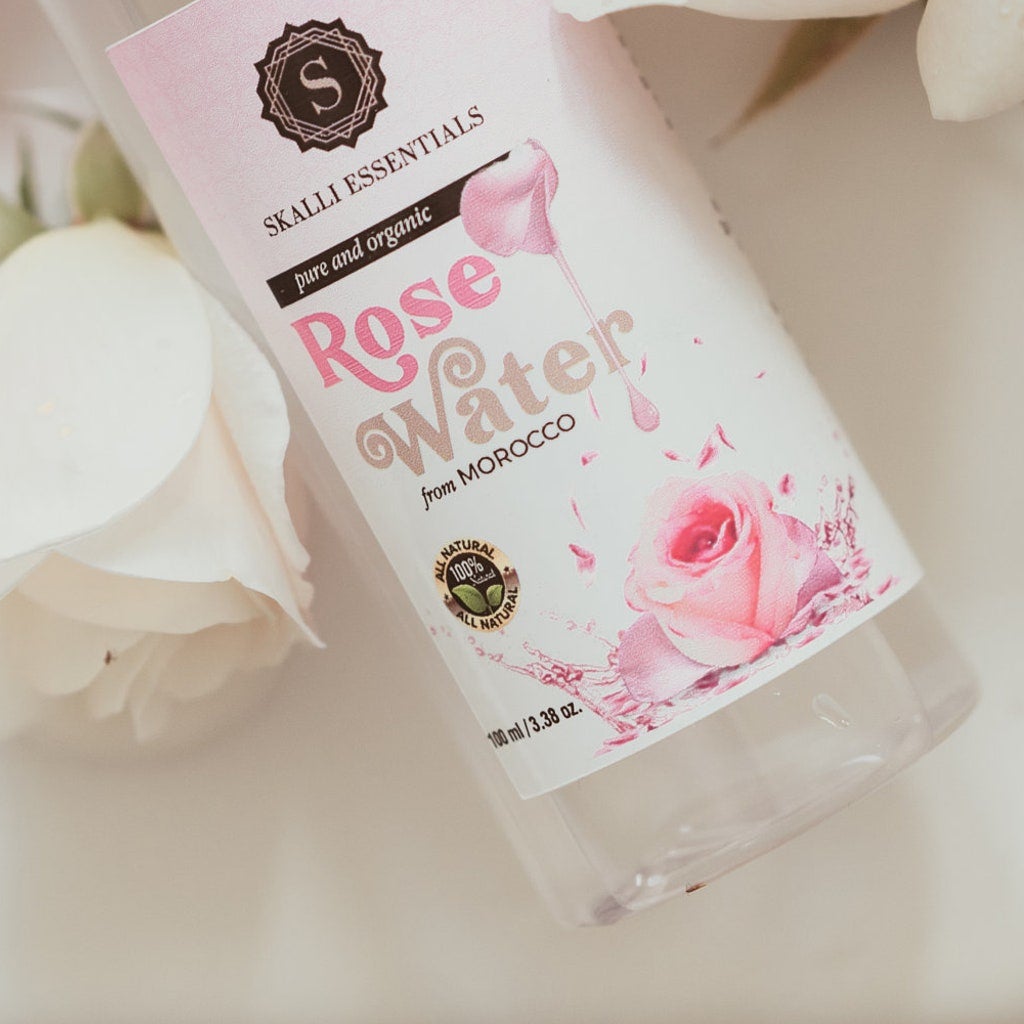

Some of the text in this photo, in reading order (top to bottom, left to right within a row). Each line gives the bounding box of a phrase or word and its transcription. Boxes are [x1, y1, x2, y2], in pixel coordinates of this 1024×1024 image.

[299, 56, 343, 116] S
[263, 105, 486, 238] SKALLI ESSENTIALS
[294, 206, 434, 295] pure and organic
[291, 255, 502, 394] Rose
[355, 309, 634, 476] Water
[420, 413, 576, 511] from MOROCCO
[435, 560, 447, 583] ALL
[440, 539, 496, 560] NATURAL
[449, 556, 485, 583] 100%
[456, 586, 518, 630] ALL NATURAL
[487, 728, 509, 749] 100
[507, 721, 525, 742] ml
[528, 707, 560, 733] 3.38
[559, 702, 583, 719] oz.
